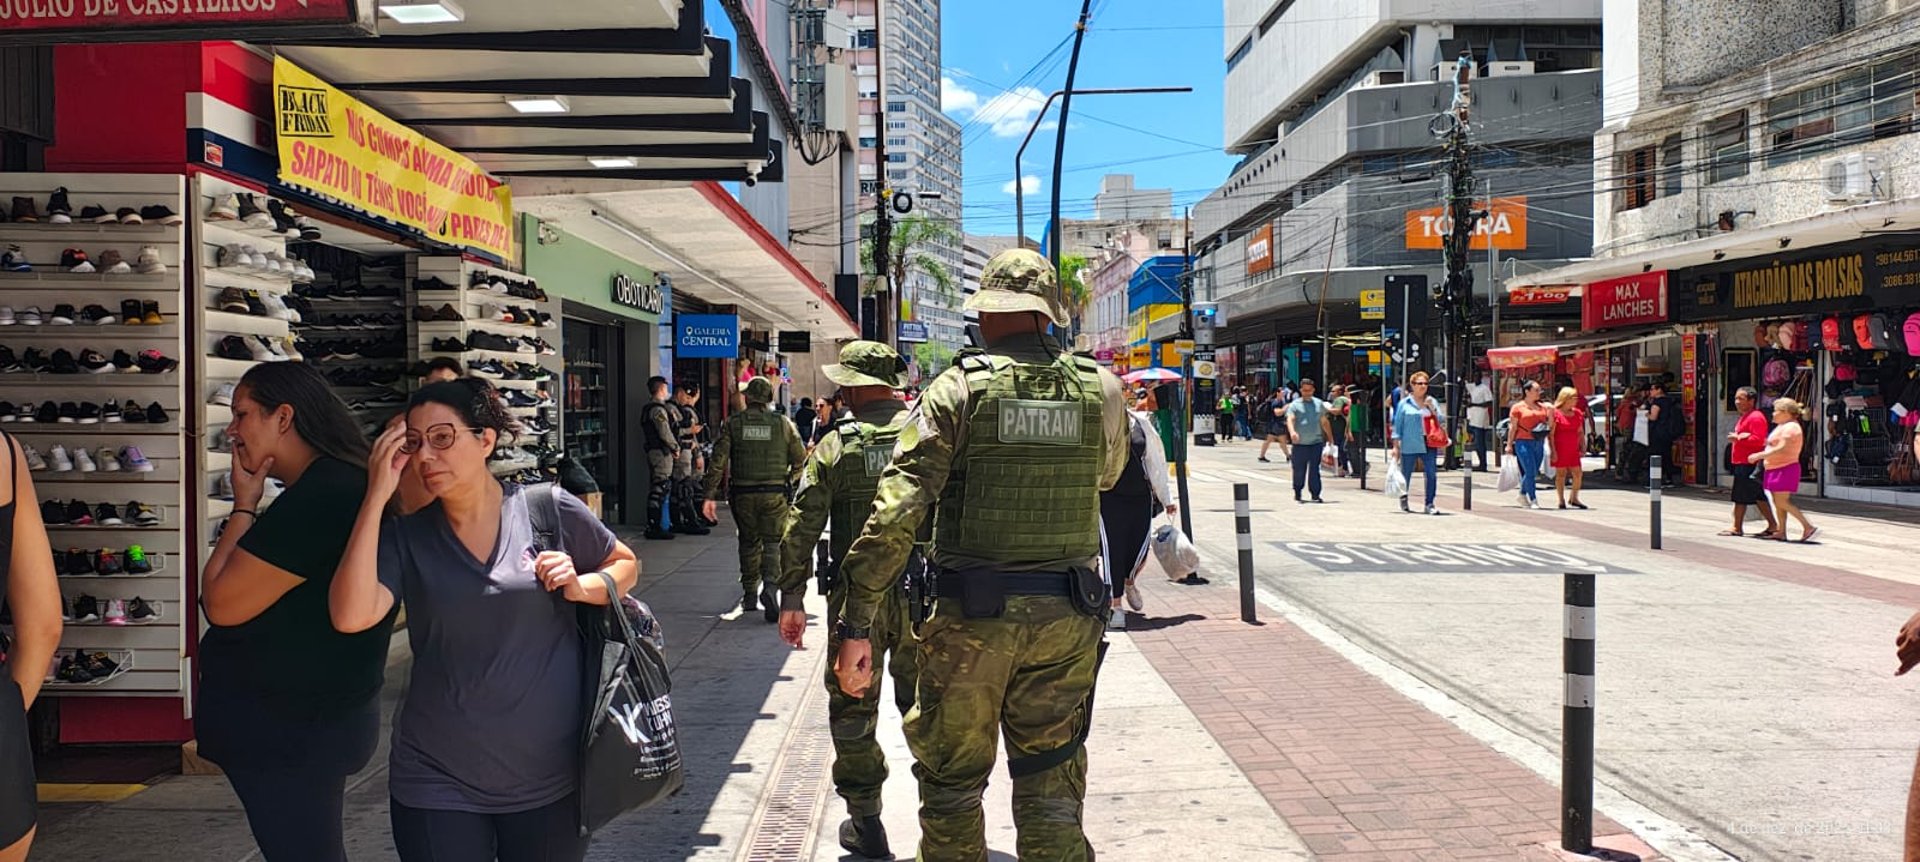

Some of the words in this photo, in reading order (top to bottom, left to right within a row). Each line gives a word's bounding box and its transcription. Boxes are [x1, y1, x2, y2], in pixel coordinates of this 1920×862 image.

[83, 0, 119, 17] DE
[282, 90, 326, 114] BLACK
[282, 113, 330, 133] FRIDAY
[291, 141, 348, 192] SAPATO
[1420, 212, 1512, 237] TORA
[1615, 281, 1640, 300] MAX
[1734, 260, 1789, 308] ATACADÃO
[1789, 261, 1814, 302] DAS
[1815, 253, 1864, 299] BOLSAS
[1603, 299, 1655, 321] LANCHES
[682, 336, 731, 347] CENTRAL
[694, 327, 731, 336] GALERIA
[743, 428, 769, 438] PATRAM
[1002, 407, 1079, 438] PATRAM
